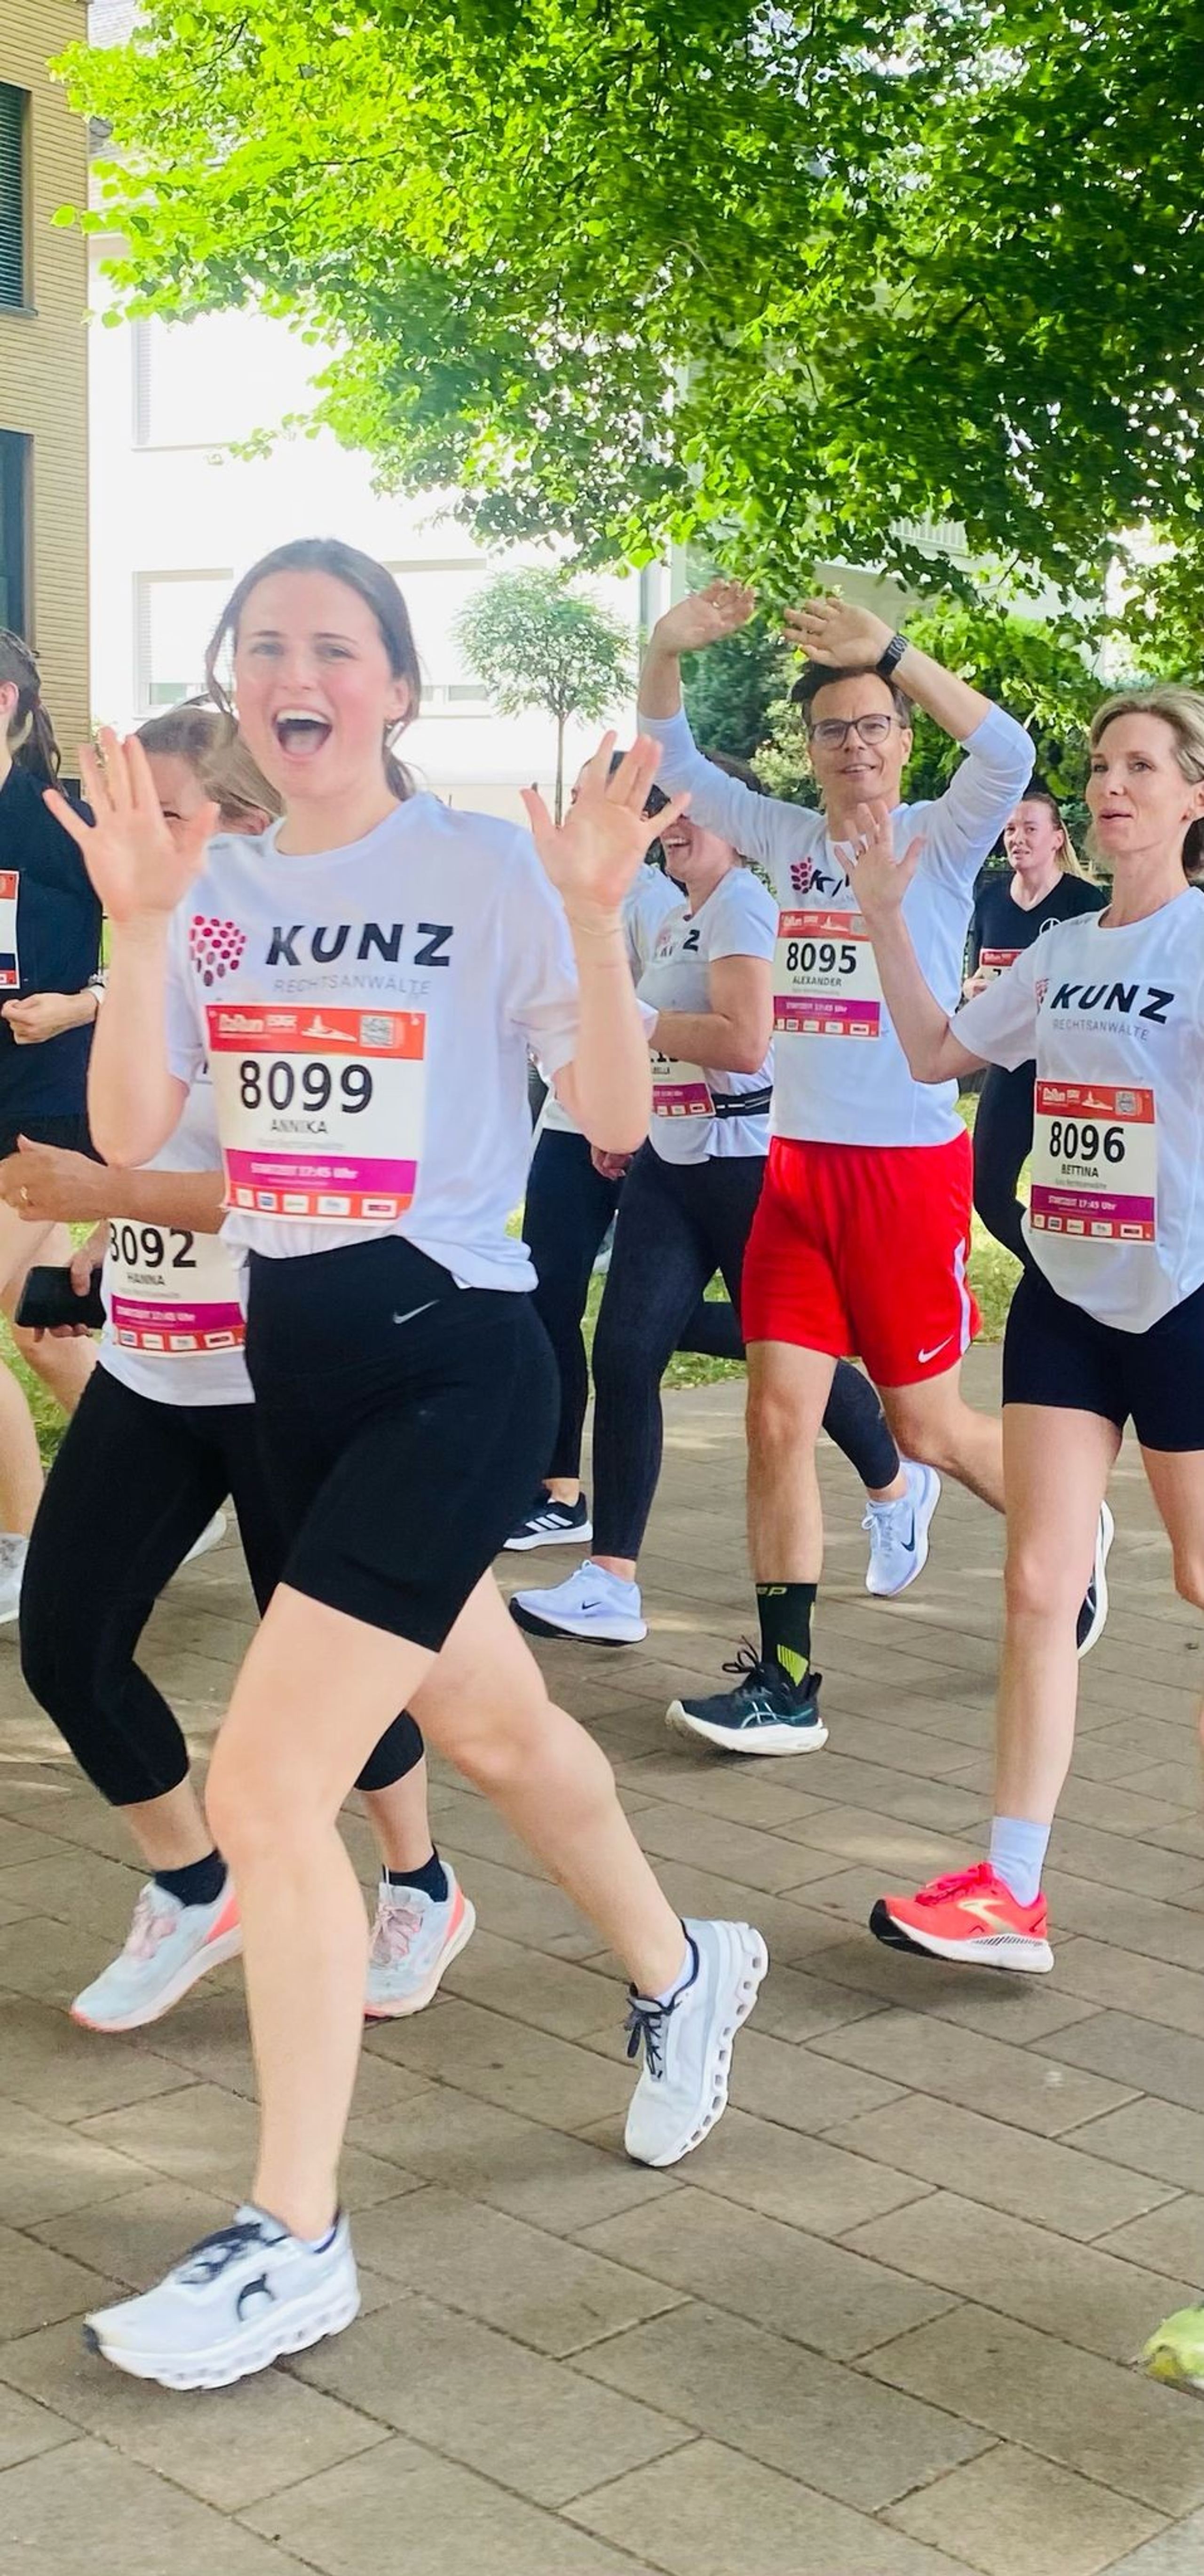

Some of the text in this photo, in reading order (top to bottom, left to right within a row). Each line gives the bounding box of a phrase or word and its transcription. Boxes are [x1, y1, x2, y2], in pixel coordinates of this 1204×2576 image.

[265, 922, 454, 967] KUNZ
[786, 942, 856, 974] 8095
[792, 976, 842, 987] ALEXANDER
[1050, 982, 1175, 1025] KUNZ
[239, 1060, 373, 1114] 8099
[271, 1119, 329, 1134] ANNIKA
[1049, 1121, 1125, 1163] 8096
[1061, 1163, 1099, 1178] BETTINA
